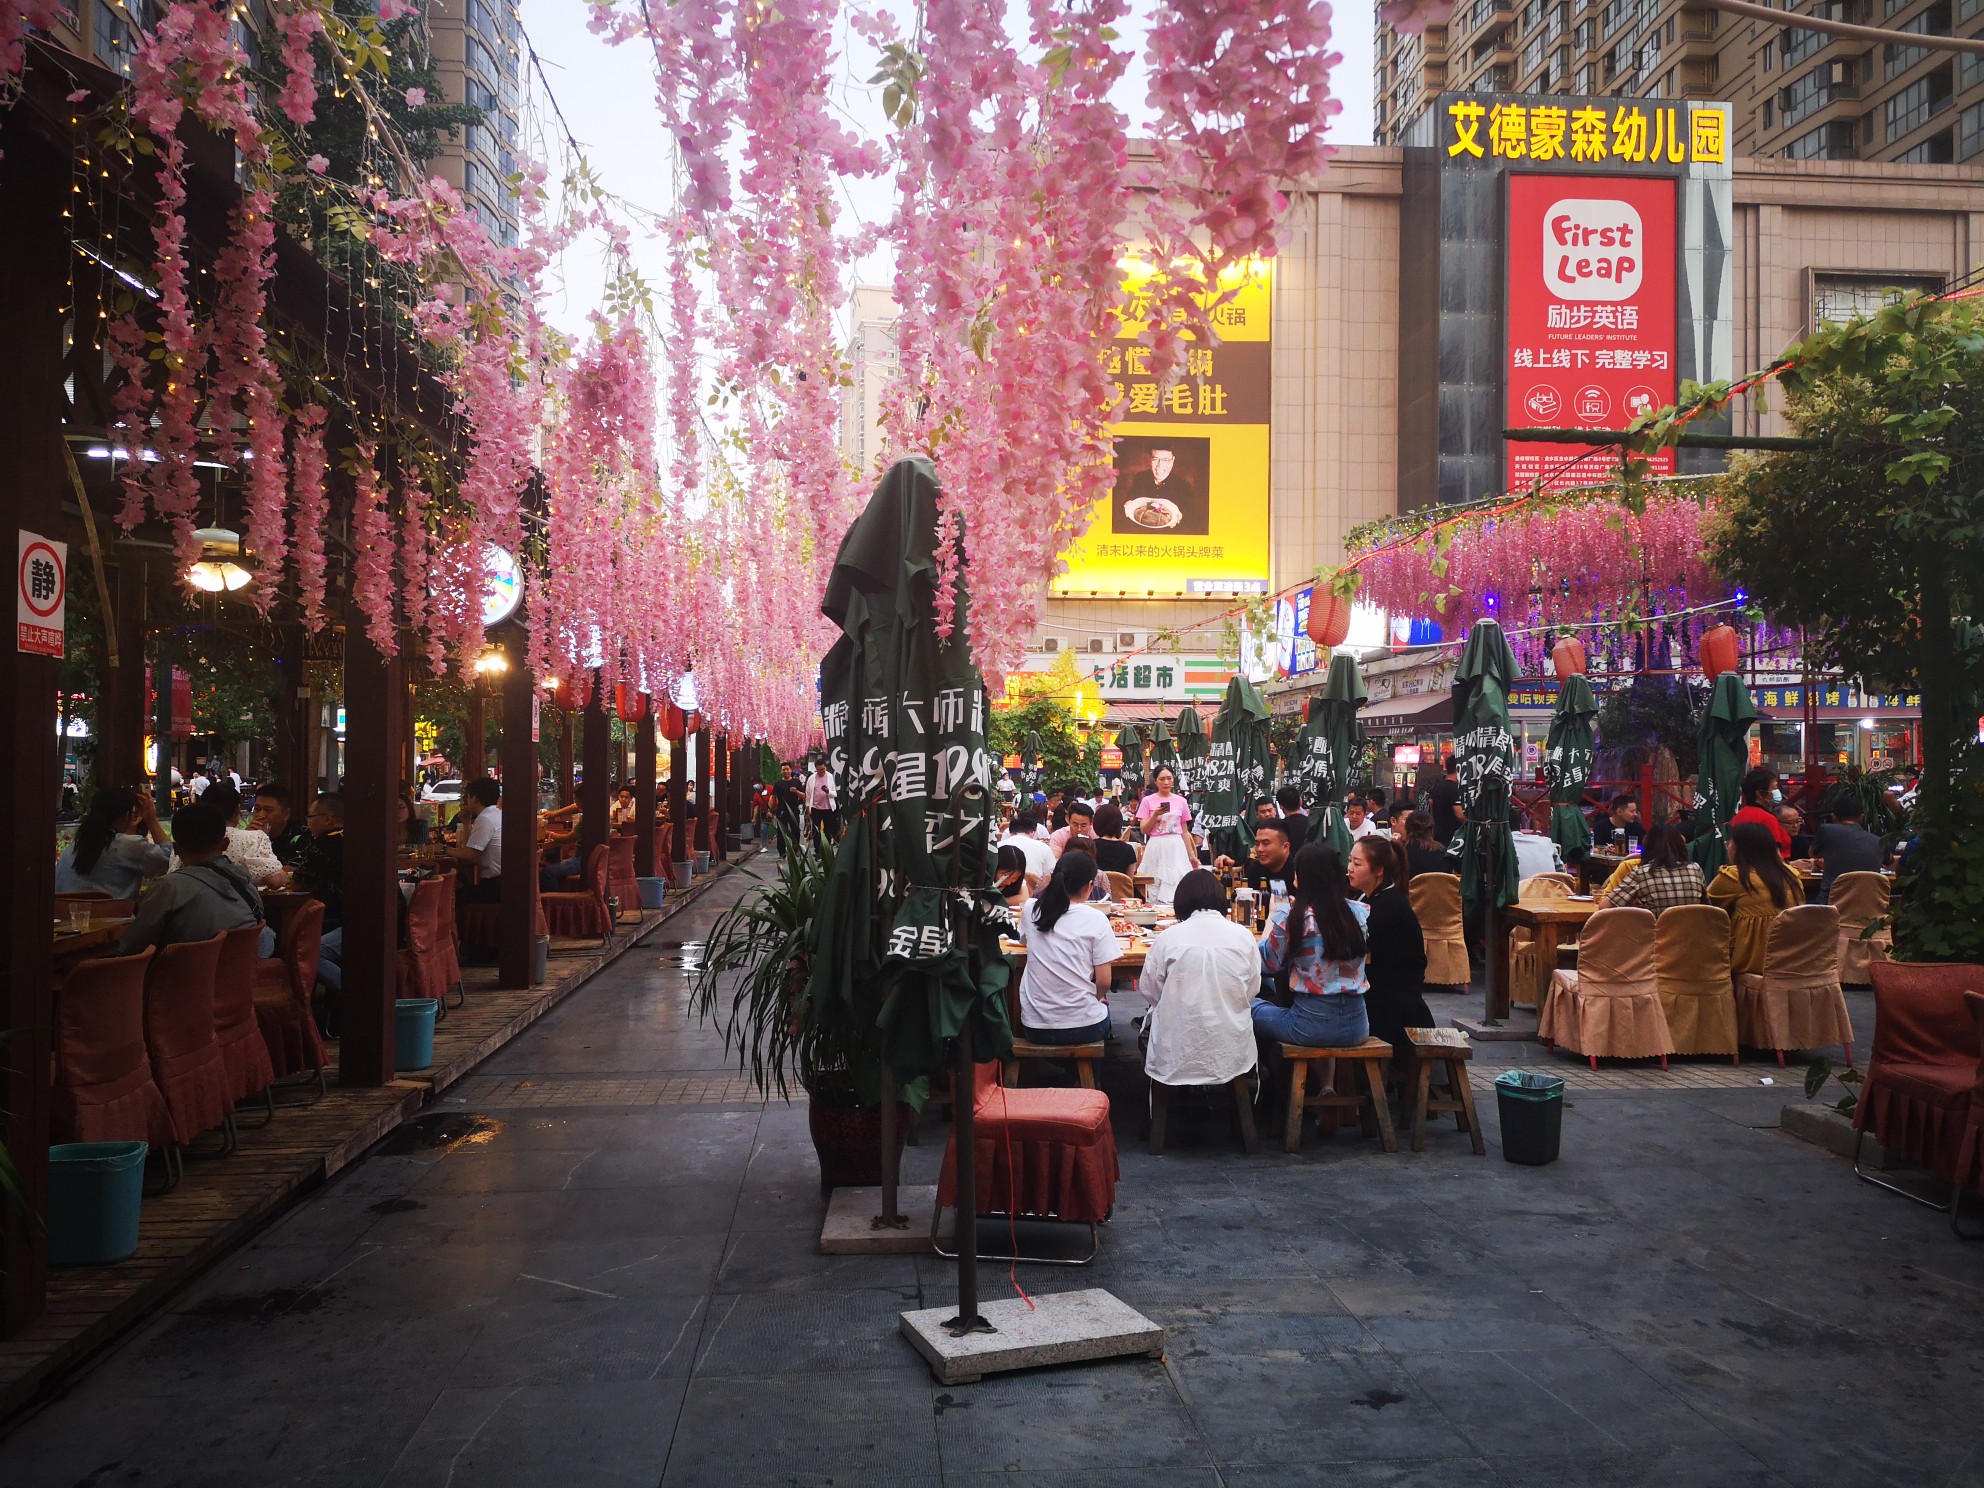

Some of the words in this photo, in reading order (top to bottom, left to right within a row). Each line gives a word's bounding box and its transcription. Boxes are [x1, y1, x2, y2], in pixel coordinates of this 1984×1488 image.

[1448, 101, 1725, 164] 艾德蒙森幼儿园
[1551, 214, 1633, 248] First
[1558, 254, 1636, 284] Leap
[1547, 305, 1639, 329] 励步英语
[1513, 348, 1590, 369] 线上线下
[1595, 349, 1668, 370] 完整学习
[1096, 543, 1225, 559] 清末以来的火锅头牌菜
[32, 559, 55, 600] 静
[20, 625, 61, 647] 禁止大声喧哗
